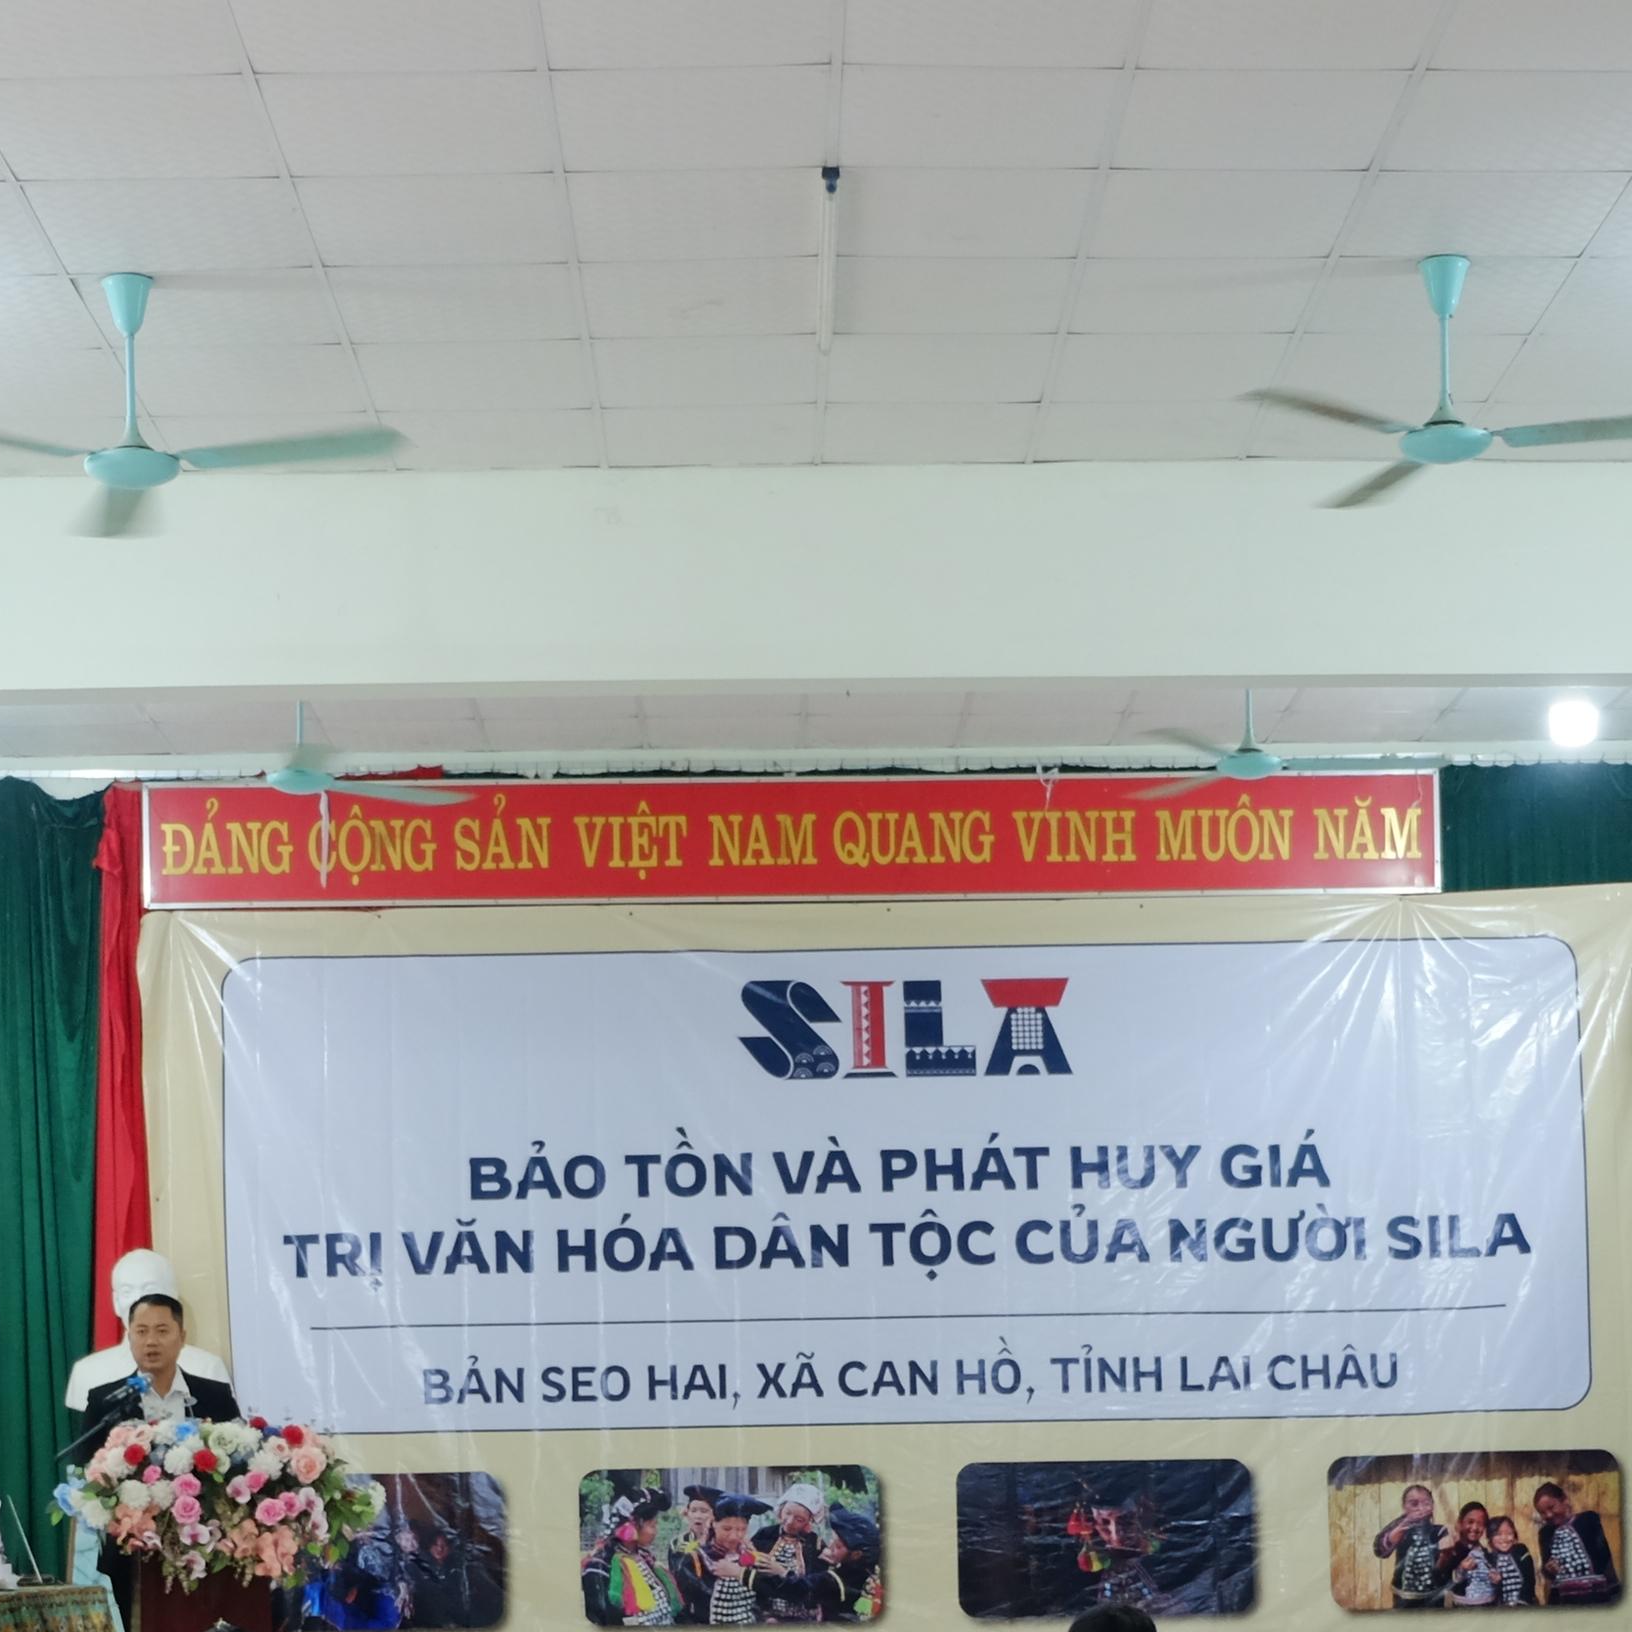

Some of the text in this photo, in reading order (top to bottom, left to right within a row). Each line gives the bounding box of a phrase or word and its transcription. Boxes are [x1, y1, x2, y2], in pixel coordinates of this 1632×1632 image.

[160, 794, 1422, 886] ĐẢNG CỘNG SẢN VIỆT NAM QUANG VINH MUÔN NĂM
[738, 978, 1073, 1079] SILA
[469, 1127, 1331, 1200] BẢO TỒN VÀ PHÁT HUY GIÁ
[284, 1203, 1531, 1288] TRỊ VĂN HÓA DÂN TỘC CỦA NGƯỜI SILA
[422, 1336, 1398, 1409] BẢN SEO HAI, XÃ CAN HỒ, TỈNH LAI CHÂU
